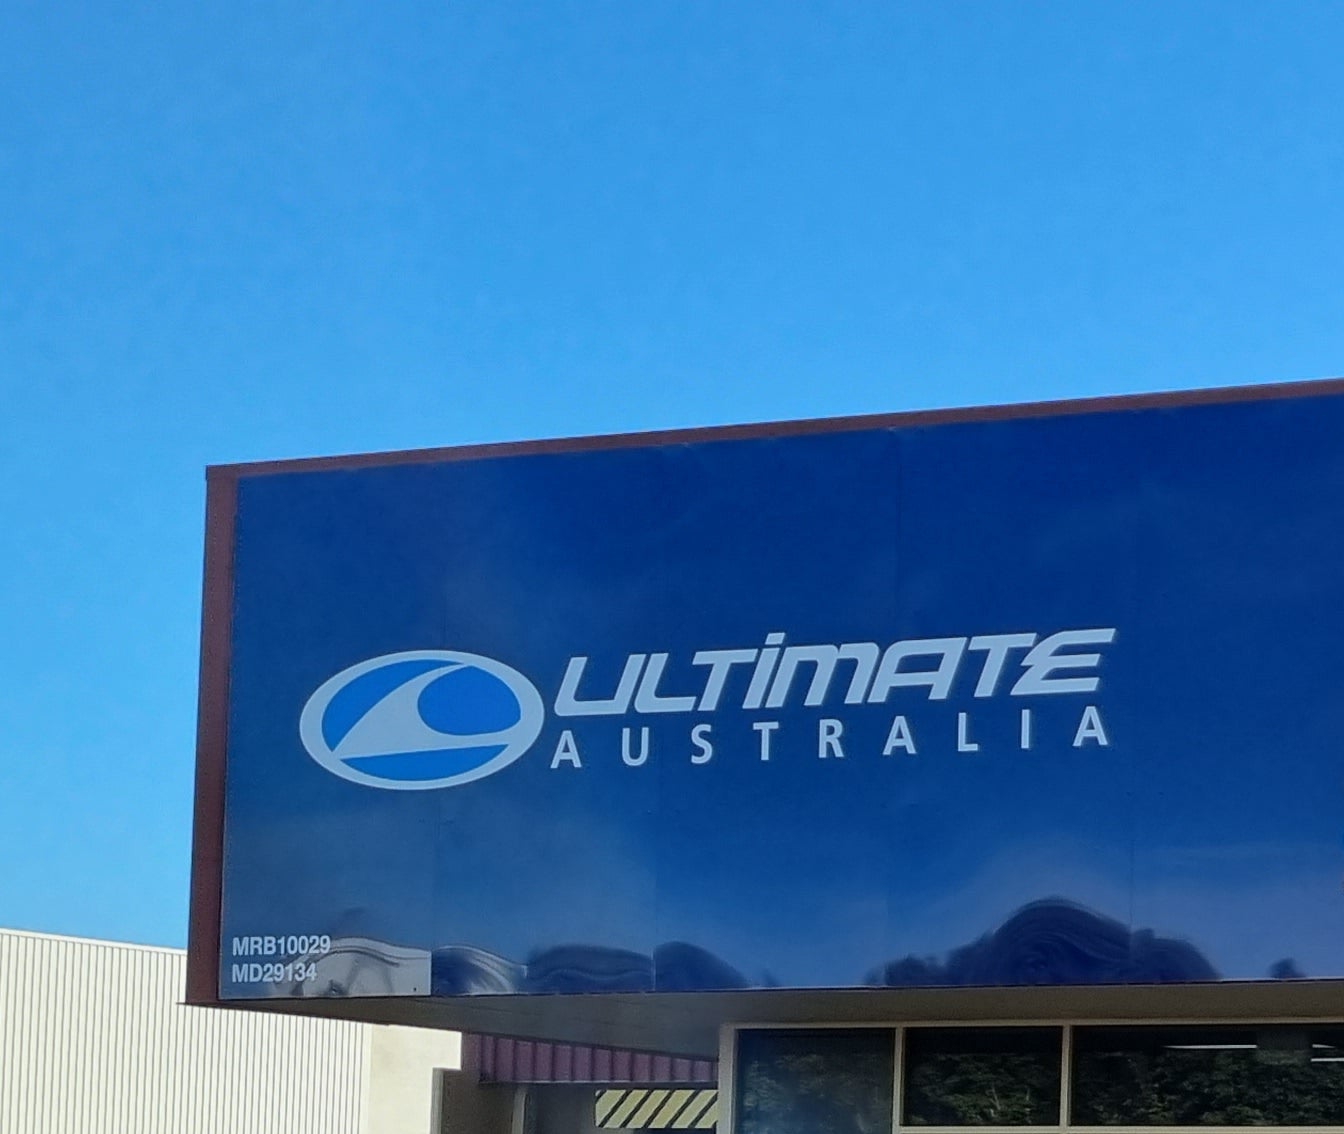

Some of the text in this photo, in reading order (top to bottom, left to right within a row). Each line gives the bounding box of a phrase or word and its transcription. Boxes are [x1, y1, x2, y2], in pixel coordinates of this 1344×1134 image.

[549, 704, 1110, 770] AUSTRALIA
[232, 934, 332, 957] MRB10029
[231, 961, 318, 983] MD29134
